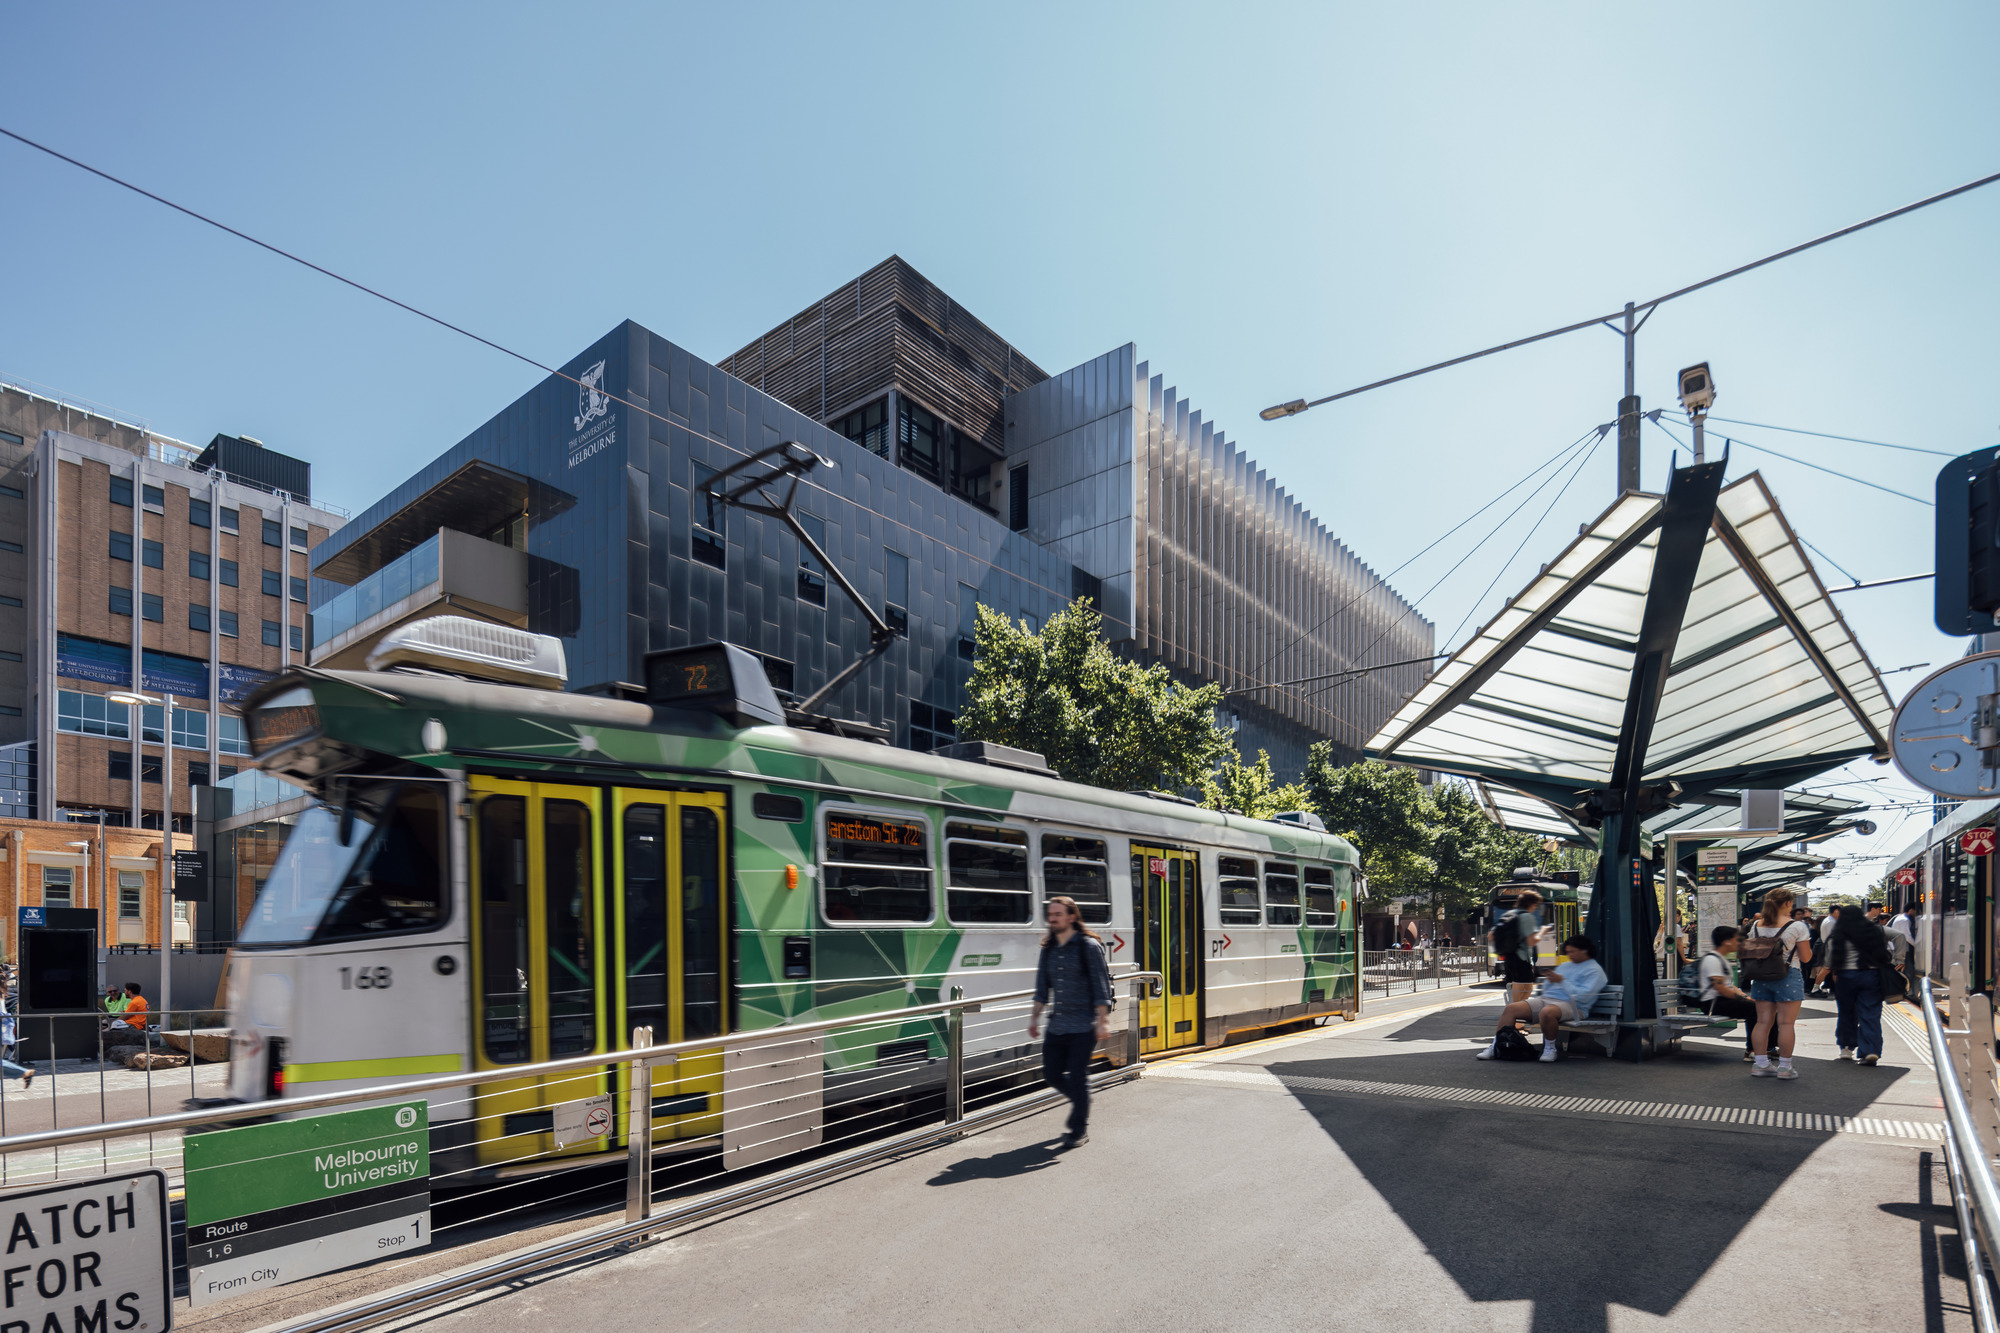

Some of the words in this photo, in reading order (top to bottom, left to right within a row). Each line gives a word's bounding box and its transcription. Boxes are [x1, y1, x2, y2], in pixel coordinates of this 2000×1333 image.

[568, 438, 578, 449] THE
[578, 419, 609, 443] UNIVERSITY
[608, 414, 616, 425] OF
[568, 431, 616, 469] MELBOURNE
[67, 667, 117, 682] MELBOURNE
[78, 663, 109, 672] UNIVERSITY
[684, 665, 707, 691] 72
[151, 682, 197, 695] MELBOURNE
[161, 677, 189, 686] UNIVERSITY
[828, 820, 881, 843] anston
[882, 822, 901, 844] St
[901, 824, 921, 846] 72
[1966, 831, 1994, 840] STOP
[1150, 860, 1167, 872] STOP
[339, 966, 393, 990] 168
[315, 1141, 419, 1172] Melbourne
[324, 1159, 419, 1189] University
[6, 1191, 136, 1255] ATCH
[206, 1221, 248, 1238] Route
[377, 1235, 406, 1249] Stop
[410, 1219, 420, 1239] 1
[206, 1247, 220, 1258] 1,
[223, 1243, 232, 1255] 6
[4, 1251, 102, 1309] FOR
[208, 1276, 247, 1294] From
[251, 1268, 280, 1283] City
